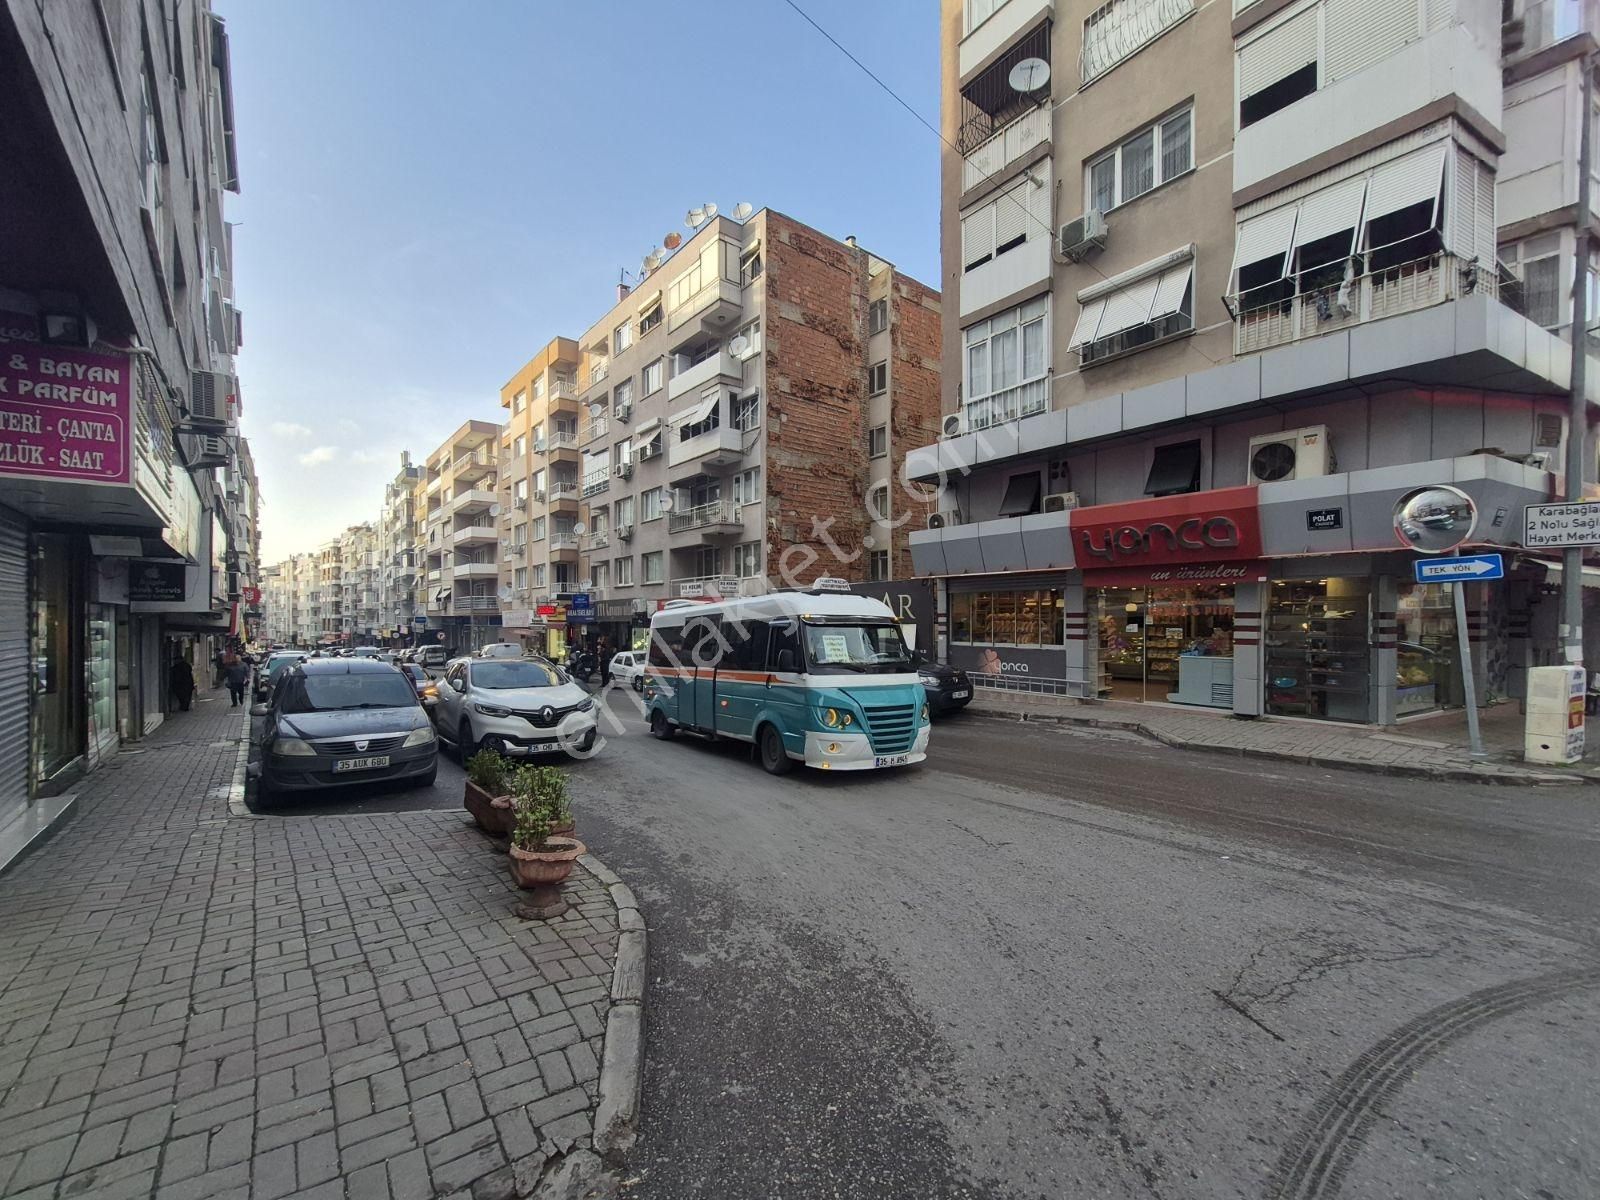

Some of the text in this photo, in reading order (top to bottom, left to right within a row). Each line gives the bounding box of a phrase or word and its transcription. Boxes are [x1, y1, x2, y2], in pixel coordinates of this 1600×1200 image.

[8, 354, 120, 385] & BAYAN
[18, 379, 118, 408] PARFÜM
[58, 417, 117, 443] ÇANTA
[59, 448, 104, 470] SAAT
[1312, 513, 1336, 523] POLAT
[1538, 504, 1600, 517] Karabağla
[1528, 521, 1536, 530] 2
[1083, 515, 1240, 562] yonca
[1529, 533, 1563, 545] Hayat
[1151, 563, 1247, 581] un ürünleri
[1428, 564, 1471, 574] TEK YÖN
[339, 760, 350, 770] 35
[371, 757, 387, 767] 680
